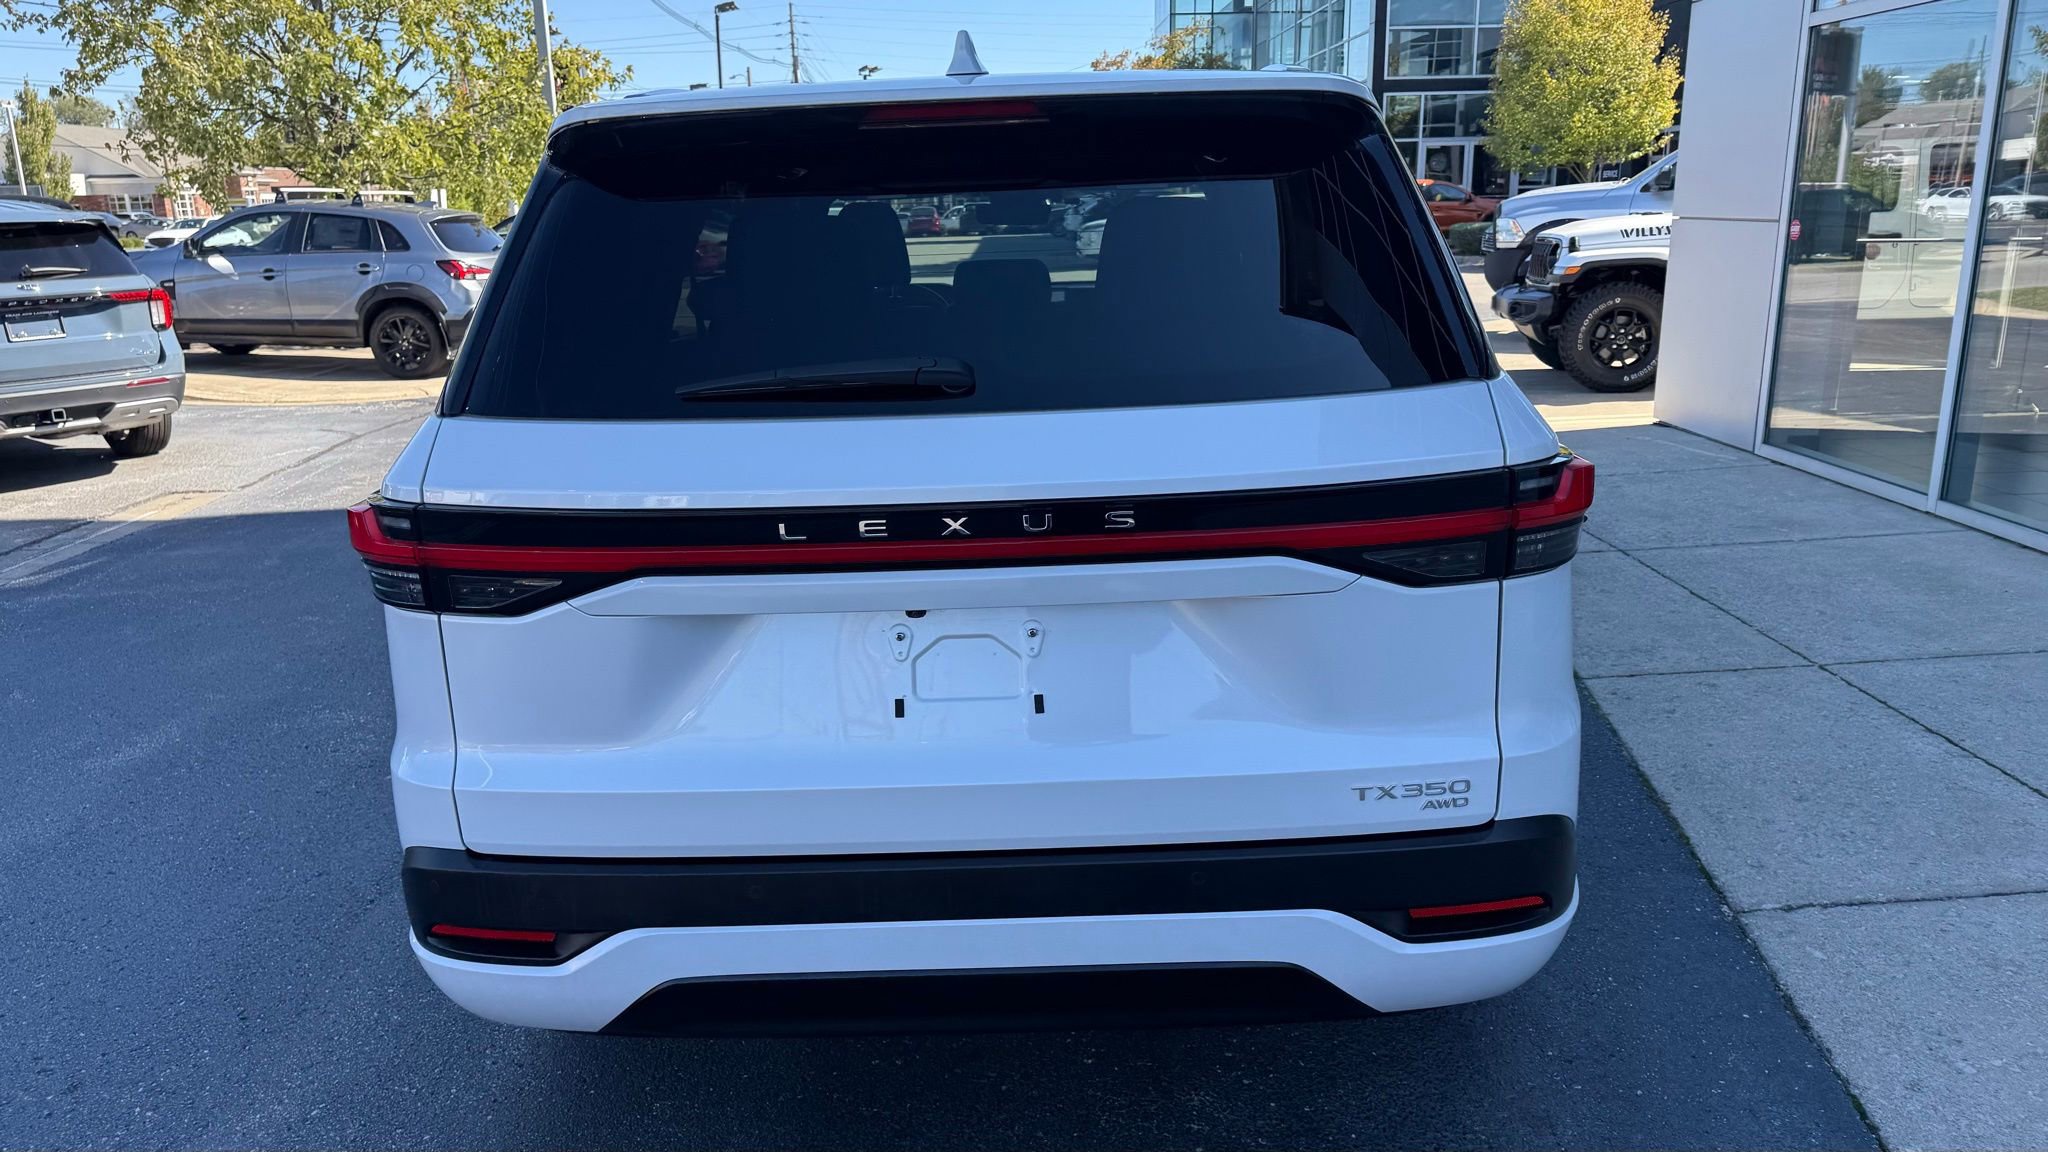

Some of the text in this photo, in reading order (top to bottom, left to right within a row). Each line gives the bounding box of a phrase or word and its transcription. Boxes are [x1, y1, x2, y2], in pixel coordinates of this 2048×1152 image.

[778, 510, 1135, 541] LEXUS
[1351, 778, 1471, 801] TX350
[1421, 797, 1469, 811] AWD
